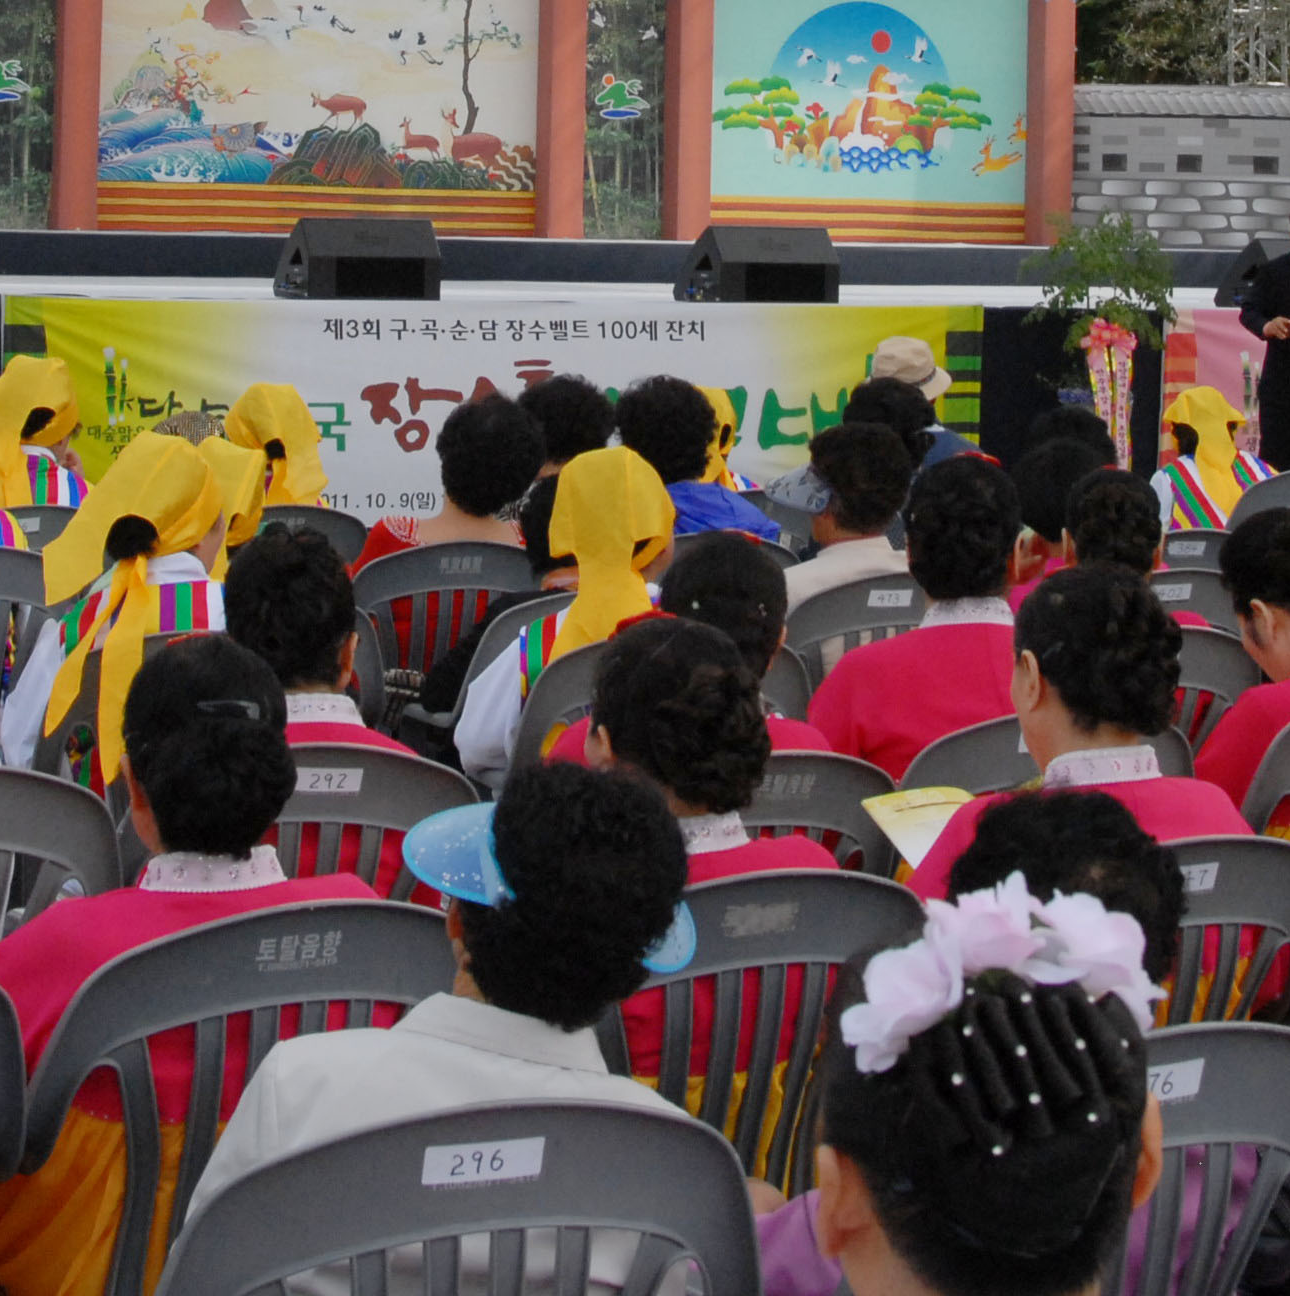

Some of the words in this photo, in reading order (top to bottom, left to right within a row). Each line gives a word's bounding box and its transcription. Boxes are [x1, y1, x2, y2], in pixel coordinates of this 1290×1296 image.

[322, 318, 381, 341] 제3회
[505, 318, 591, 341] 장수벨트
[597, 319, 658, 342] 100세
[665, 319, 706, 342] 잔치
[309, 773, 349, 790] 292
[255, 929, 343, 962] 토탈음향
[449, 1148, 505, 1177] 296
